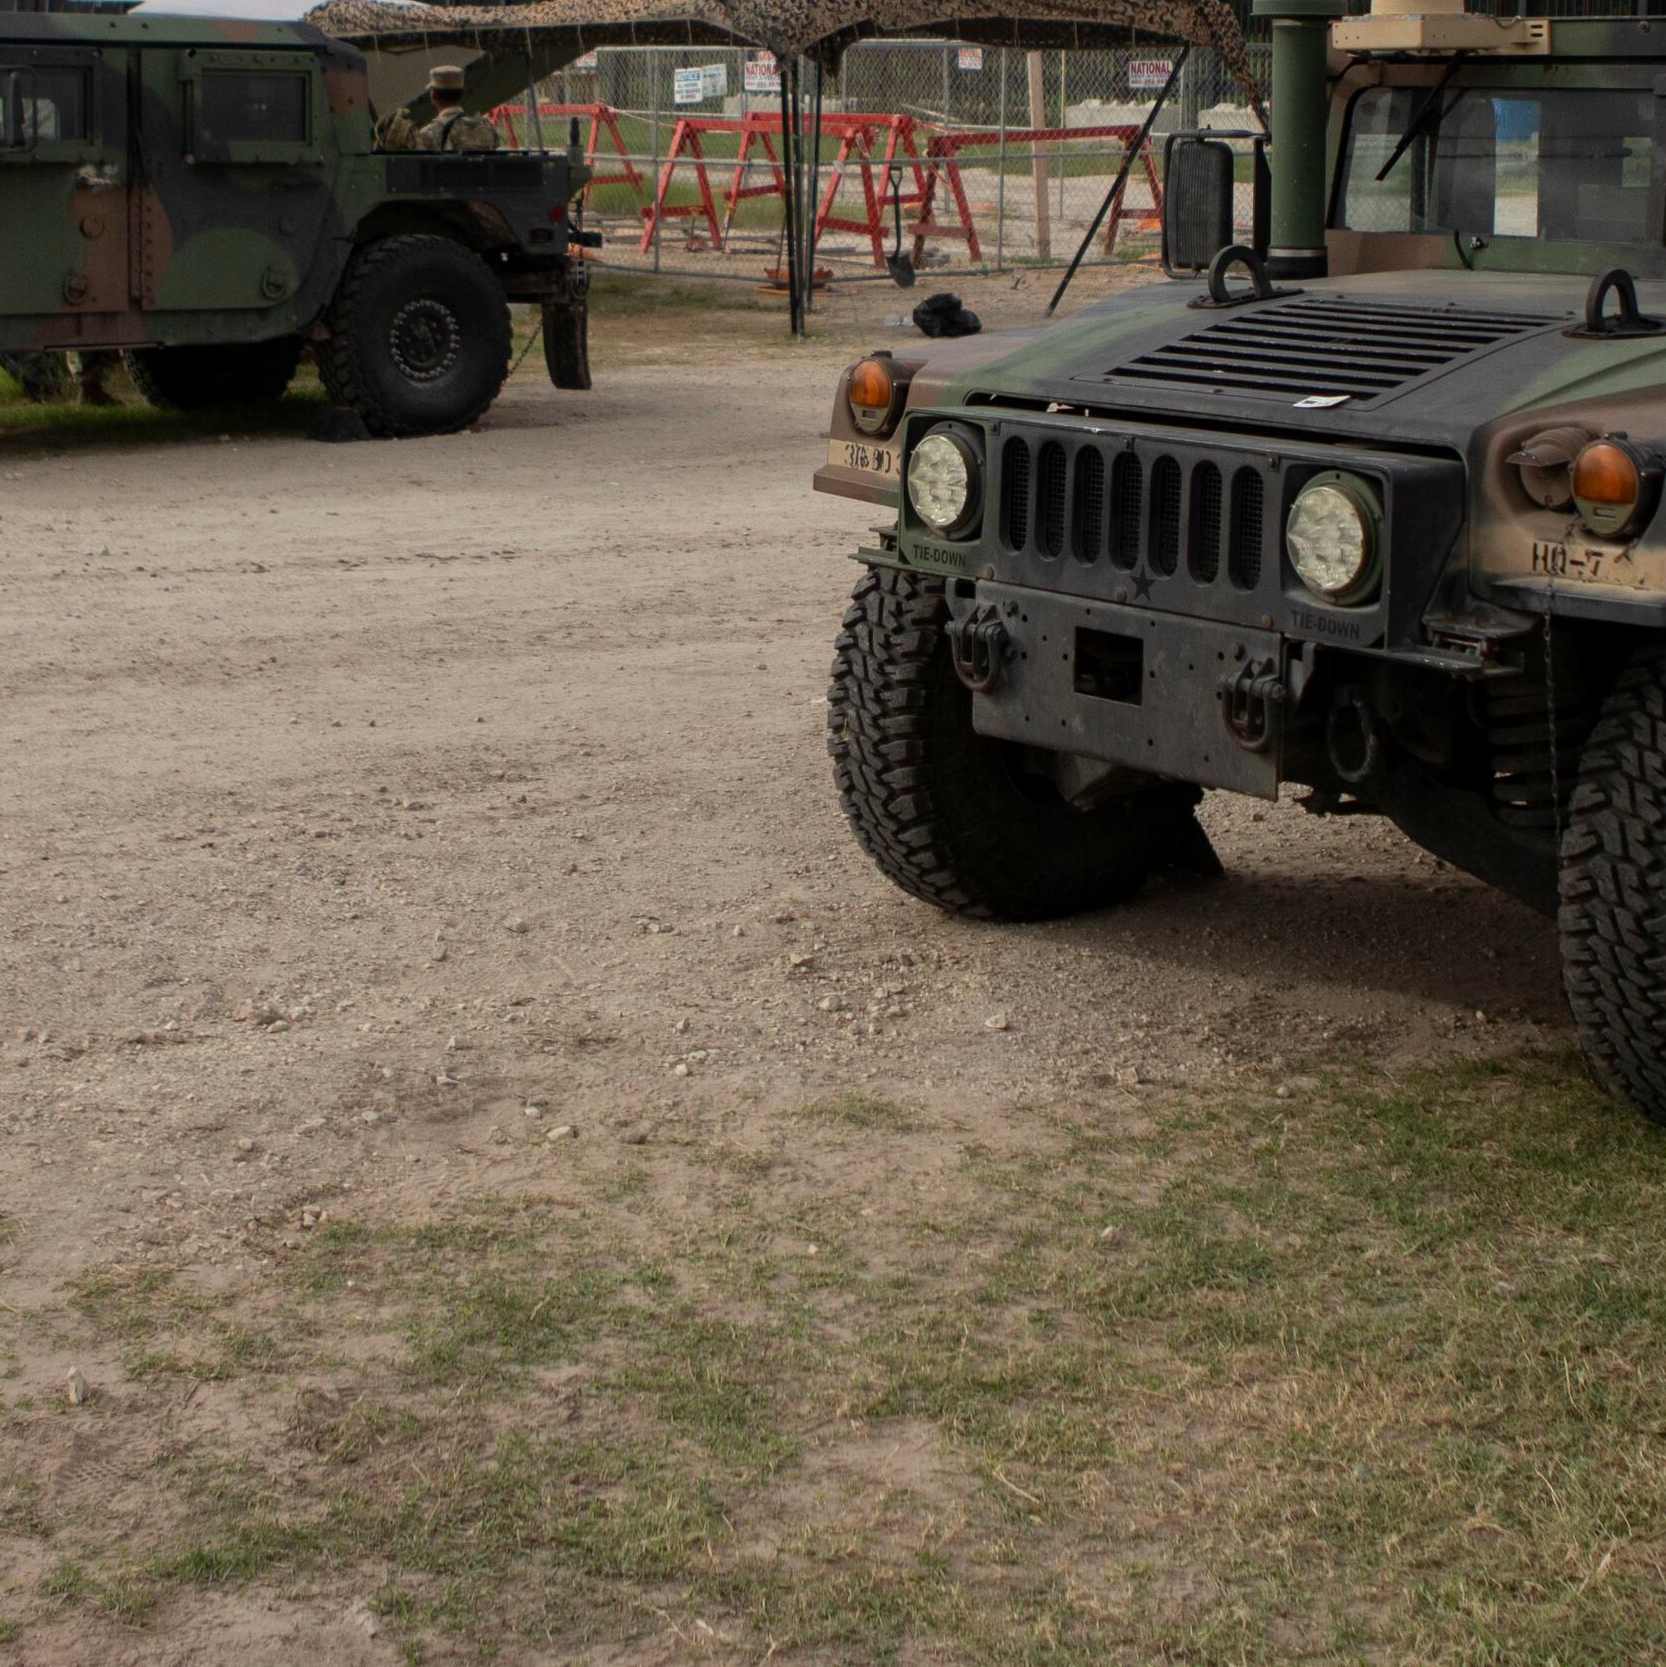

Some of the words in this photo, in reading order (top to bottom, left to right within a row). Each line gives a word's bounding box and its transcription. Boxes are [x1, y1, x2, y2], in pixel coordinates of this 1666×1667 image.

[1130, 61, 1171, 75] NATIONAL
[913, 544, 966, 568] TIE-DOWN
[1291, 610, 1359, 639] TIE-DOWN
